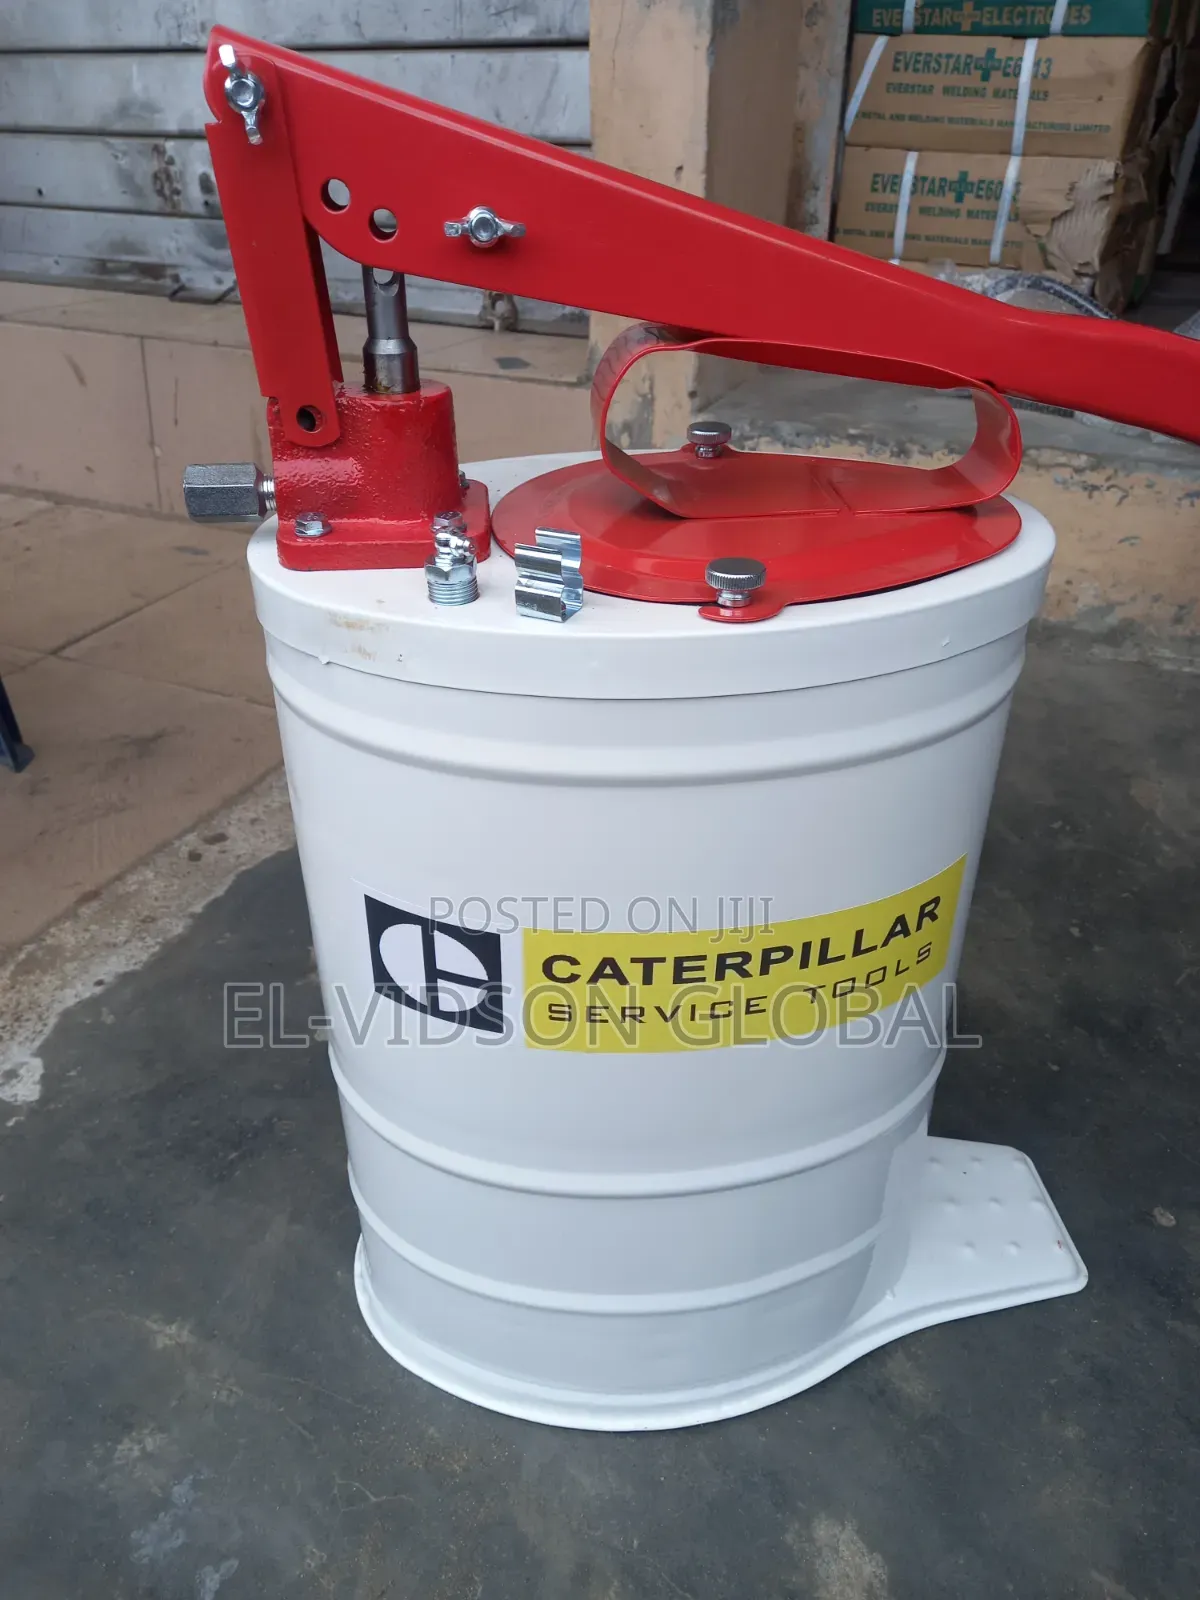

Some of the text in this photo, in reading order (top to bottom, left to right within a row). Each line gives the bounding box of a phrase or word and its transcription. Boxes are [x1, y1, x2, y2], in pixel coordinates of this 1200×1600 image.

[872, 5, 1092, 27] EVESTAR ELECTROES
[892, 51, 1053, 79] EVERSTAR E613
[886, 82, 935, 95] EVERSTAR
[942, 86, 987, 98] WELDING
[889, 113, 905, 122] AND
[947, 116, 994, 127] MATERIALS
[871, 173, 948, 198] EVESTAR
[918, 205, 961, 218] WELDING
[541, 896, 942, 984] CATERPILLAR
[548, 941, 932, 1024] SERVICE TOOLS
